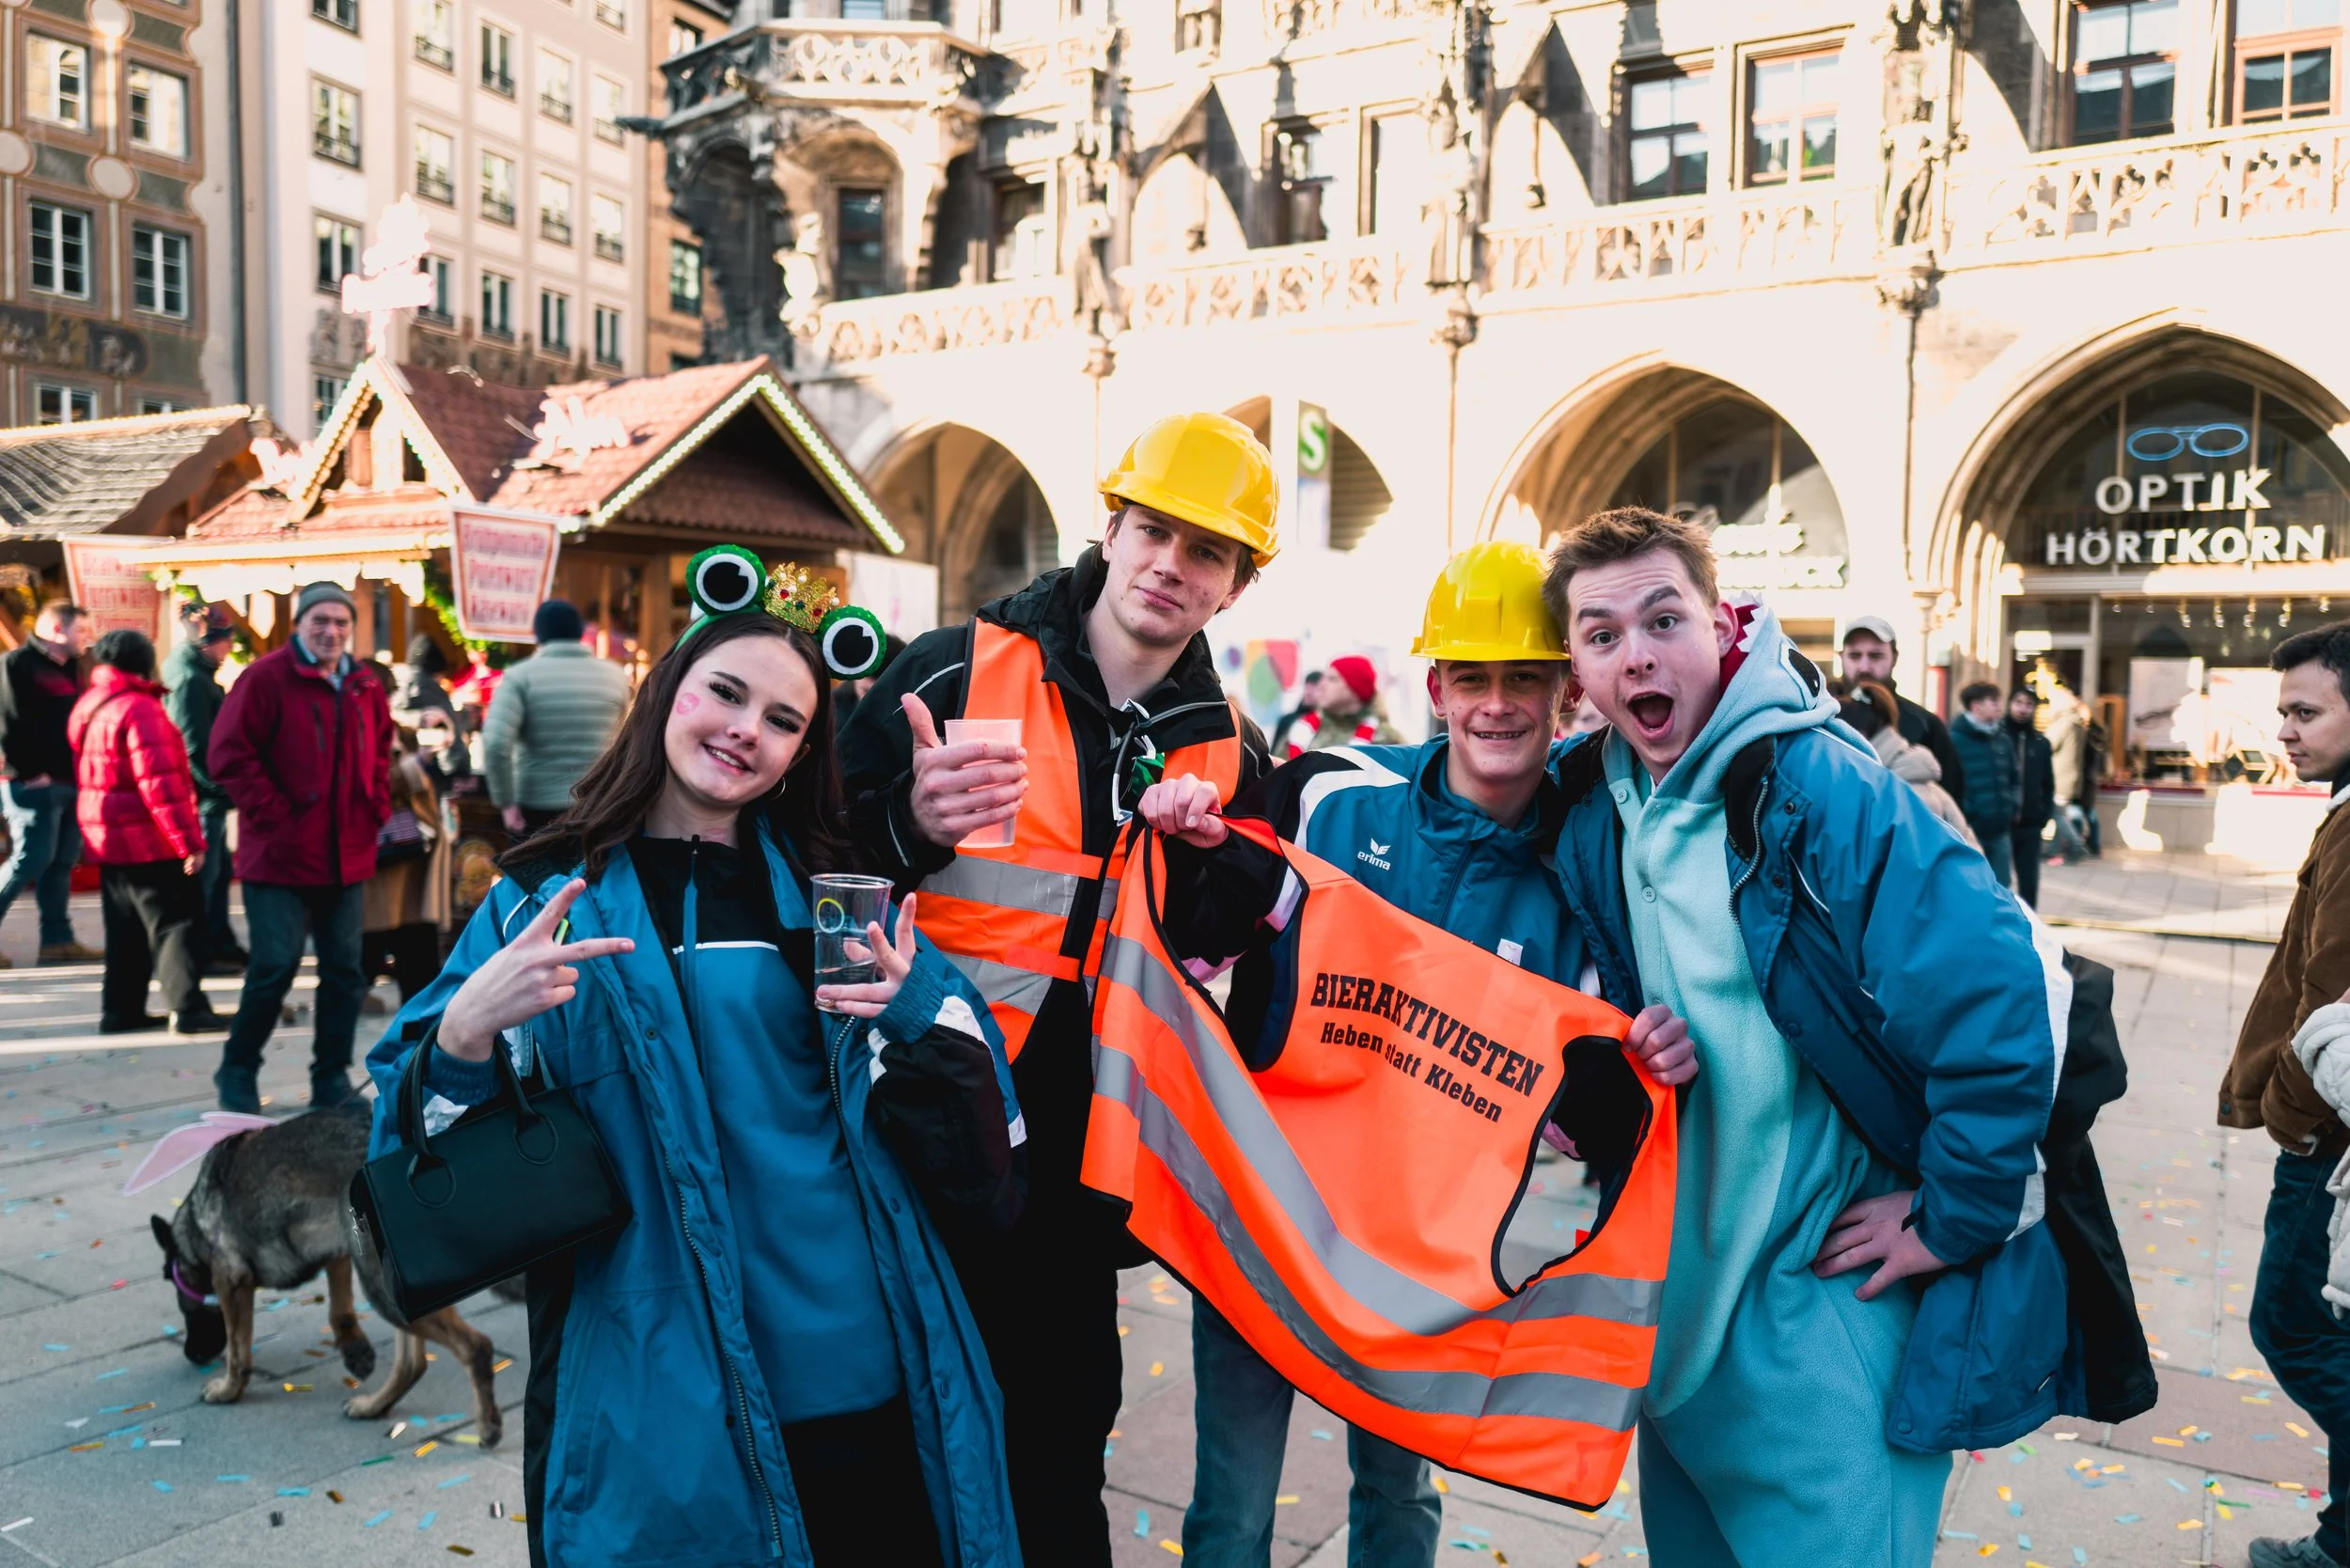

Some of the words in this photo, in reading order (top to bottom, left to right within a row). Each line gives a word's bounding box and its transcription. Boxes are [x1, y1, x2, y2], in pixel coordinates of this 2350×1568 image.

[1300, 409, 1325, 472] S
[2094, 468, 2272, 515] OPTIK
[2045, 525, 2326, 565] HÖRTKORN
[1357, 851, 1391, 871] erima
[1310, 972, 1544, 1098] BIERAKTIVISTEN
[1320, 1022, 1384, 1055] Heben
[1385, 1043, 1422, 1078] statt
[1423, 1062, 1503, 1123] Kleben
